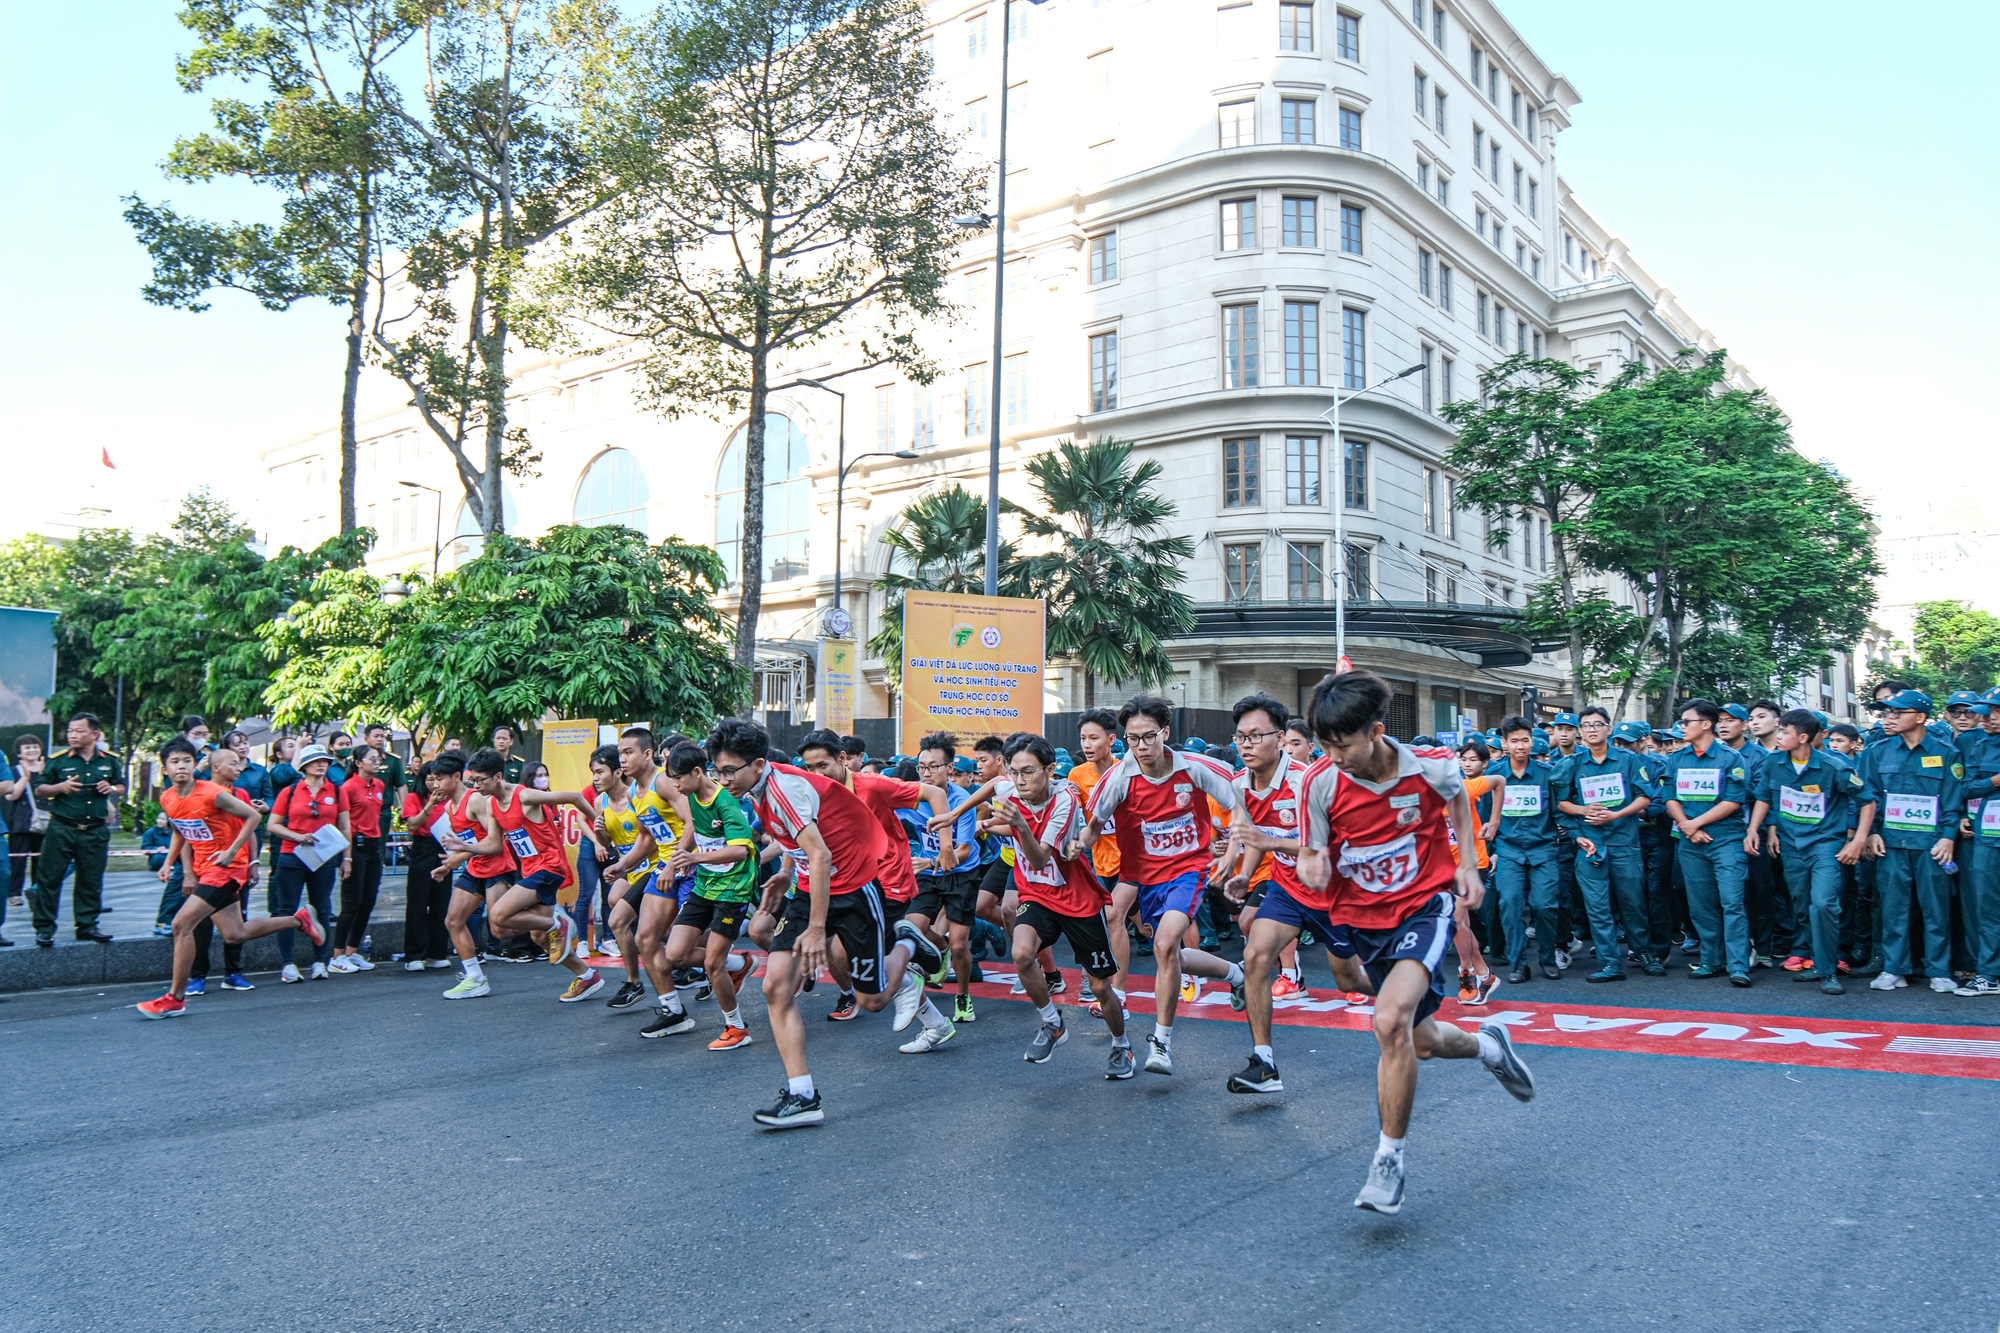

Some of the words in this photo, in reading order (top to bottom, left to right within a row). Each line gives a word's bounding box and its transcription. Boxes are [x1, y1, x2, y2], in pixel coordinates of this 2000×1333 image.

[929, 658, 943, 670] VIỆT
[975, 661, 1000, 673] LƯỢNG
[1014, 665, 1037, 673] TRANG
[947, 677, 963, 686] HỌC
[966, 678, 982, 686] SINH
[1001, 680, 1017, 689] HỌC
[940, 691, 964, 699] TRUNG
[966, 693, 983, 702] HỌC
[929, 706, 953, 715] TRUNG
[956, 708, 972, 717] HỌC
[975, 704, 990, 716] PHỔ
[993, 707, 1018, 717] THÔNG
[1694, 781, 1715, 790] 744
[1583, 790, 1595, 798] NAM
[1598, 786, 1620, 797] 745
[1516, 797, 1537, 805] 750
[1782, 799, 1792, 809] NAM
[1796, 804, 1820, 812] 774
[1887, 808, 1900, 816] NAM
[1905, 809, 1932, 819] 649
[1984, 815, 1995, 823] NAM
